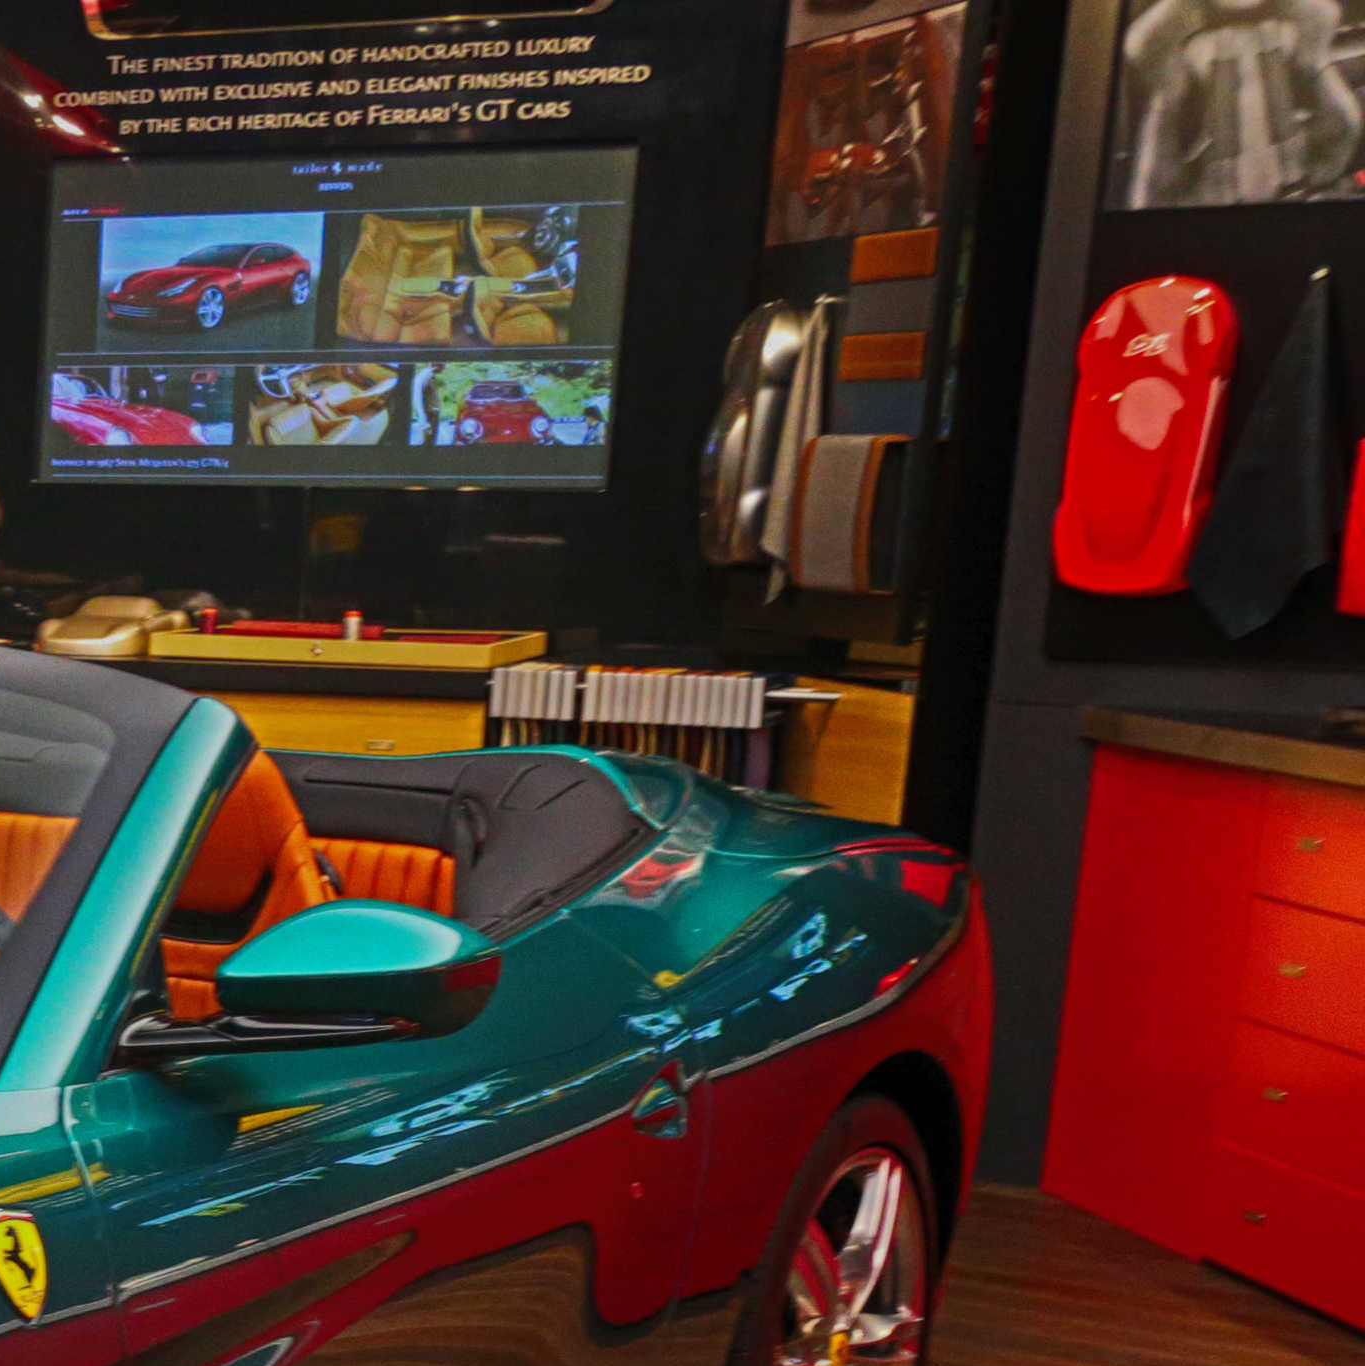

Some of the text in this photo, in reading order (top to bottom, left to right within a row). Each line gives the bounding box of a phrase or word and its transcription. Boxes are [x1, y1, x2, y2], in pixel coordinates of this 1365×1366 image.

[153, 55, 217, 73] FINEST
[220, 50, 324, 70] TRADITION
[329, 48, 359, 64] OF
[361, 41, 510, 63] HANDCRAFTED
[515, 35, 597, 56] LUXURY
[53, 65, 653, 108] COMBINED WITH EXCLUSIVE AND ELEGANT FINISHES INSPIRED
[120, 119, 143, 135] BY
[142, 117, 183, 134] THE
[186, 115, 233, 132] RICH
[237, 111, 329, 131] HERITAGE
[333, 108, 363, 126] OF
[475, 99, 517, 121] GT
[516, 101, 573, 120] CARS
